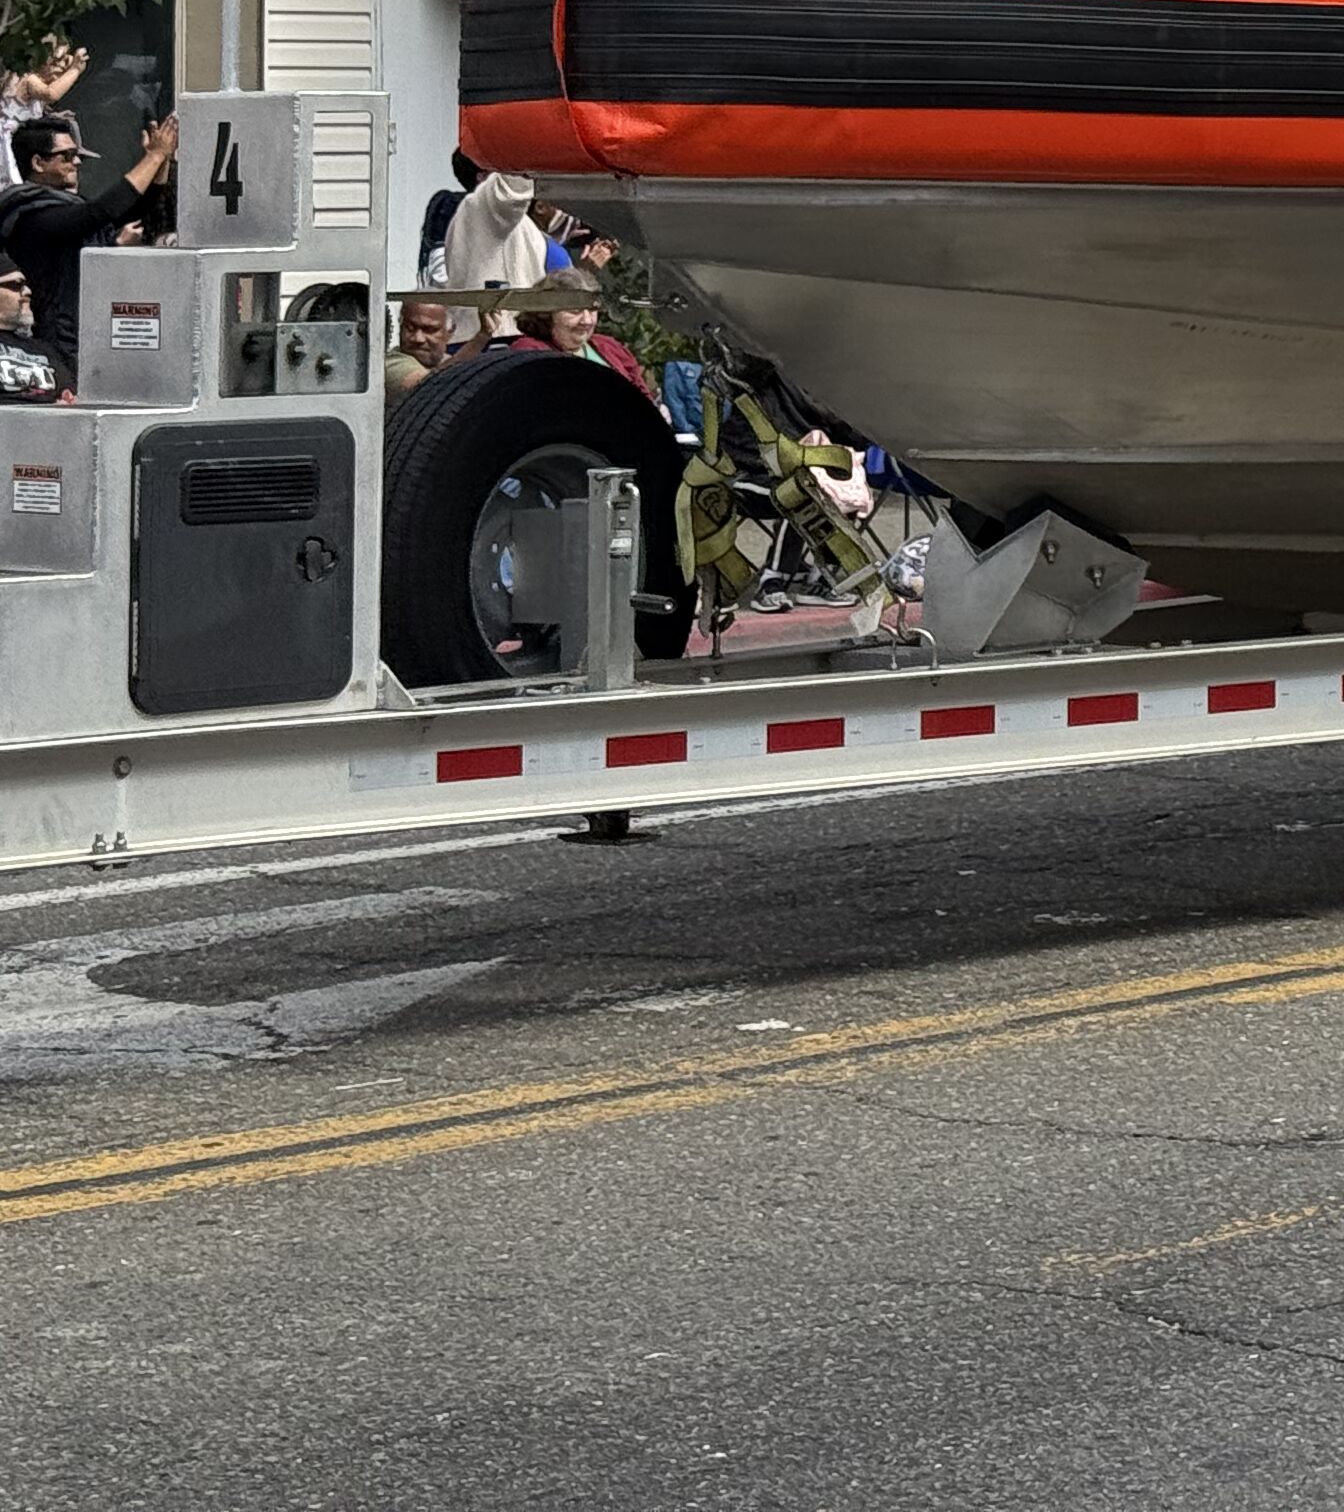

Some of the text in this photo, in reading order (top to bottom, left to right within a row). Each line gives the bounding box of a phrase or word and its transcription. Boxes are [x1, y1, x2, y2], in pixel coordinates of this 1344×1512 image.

[210, 121, 243, 216] 4
[111, 304, 160, 317] WARNING
[14, 465, 61, 480] WARNING
